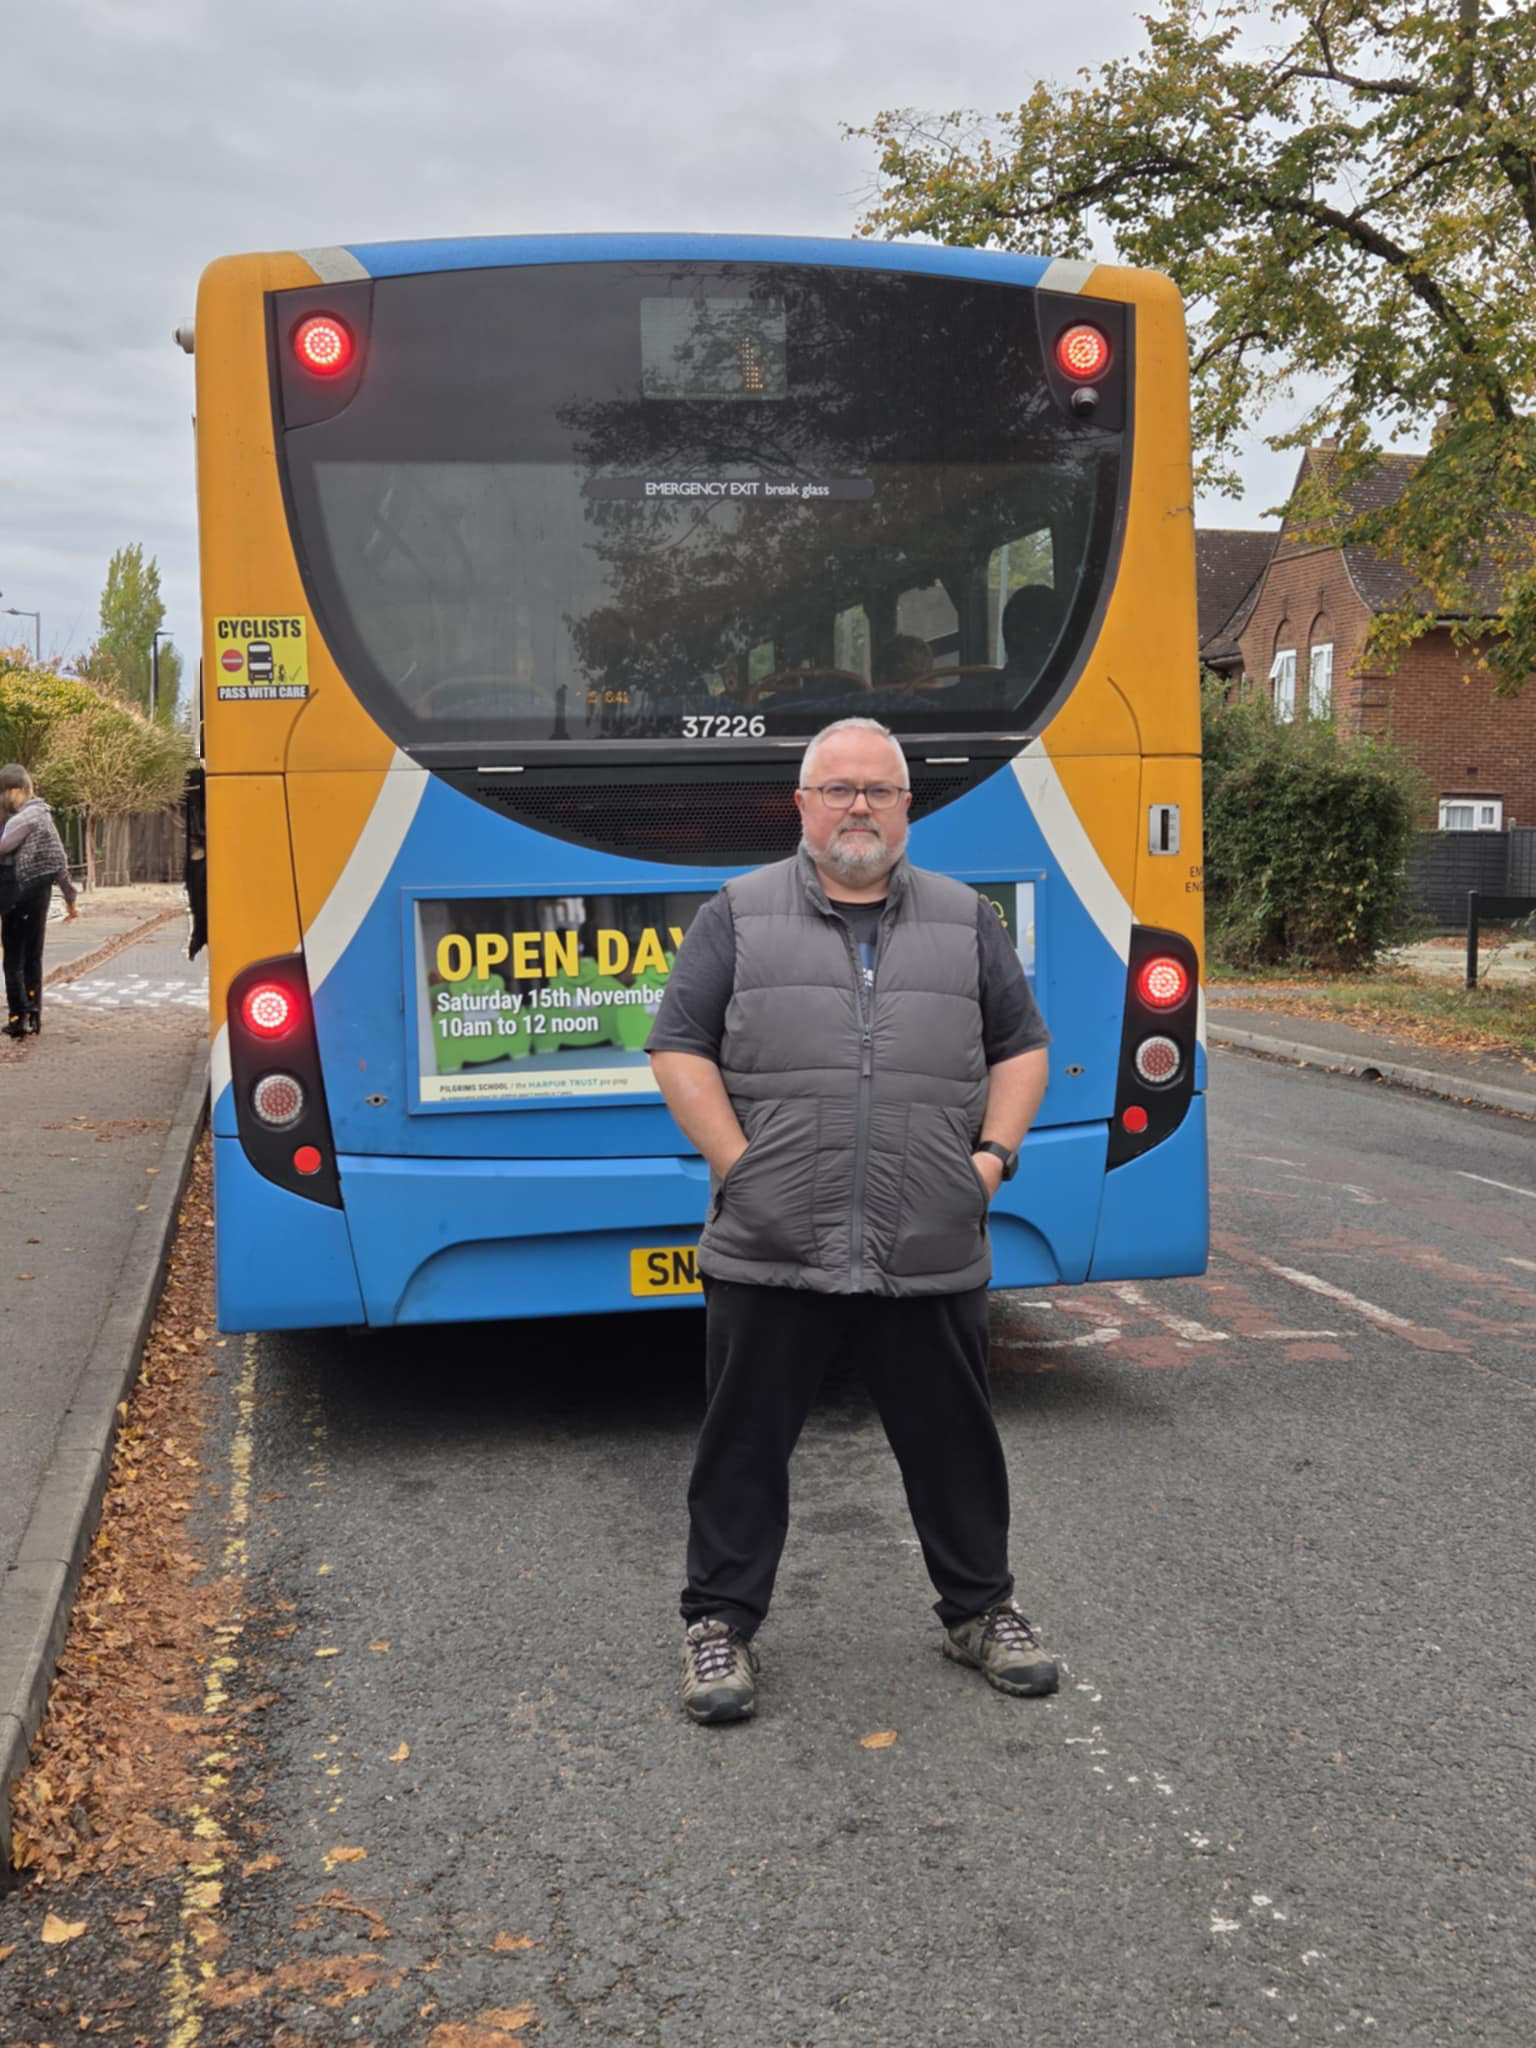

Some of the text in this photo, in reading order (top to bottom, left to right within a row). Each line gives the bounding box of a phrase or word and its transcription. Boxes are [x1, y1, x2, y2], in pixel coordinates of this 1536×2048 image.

[645, 482, 830, 499] EMERGENCY EXIT break glass
[218, 619, 301, 638] CYCLISTS
[220, 685, 306, 699] PASS WITH CARE
[682, 715, 766, 738] 37226
[437, 930, 579, 982] OPEN
[437, 985, 665, 1014] Saturday 15th Novembe
[439, 1014, 599, 1038] 10am to 12 noon
[440, 1084, 477, 1093] PILGRIMS
[478, 1082, 509, 1092] SCHOOL
[569, 1078, 599, 1087] TRUST
[647, 1250, 703, 1287] SN
